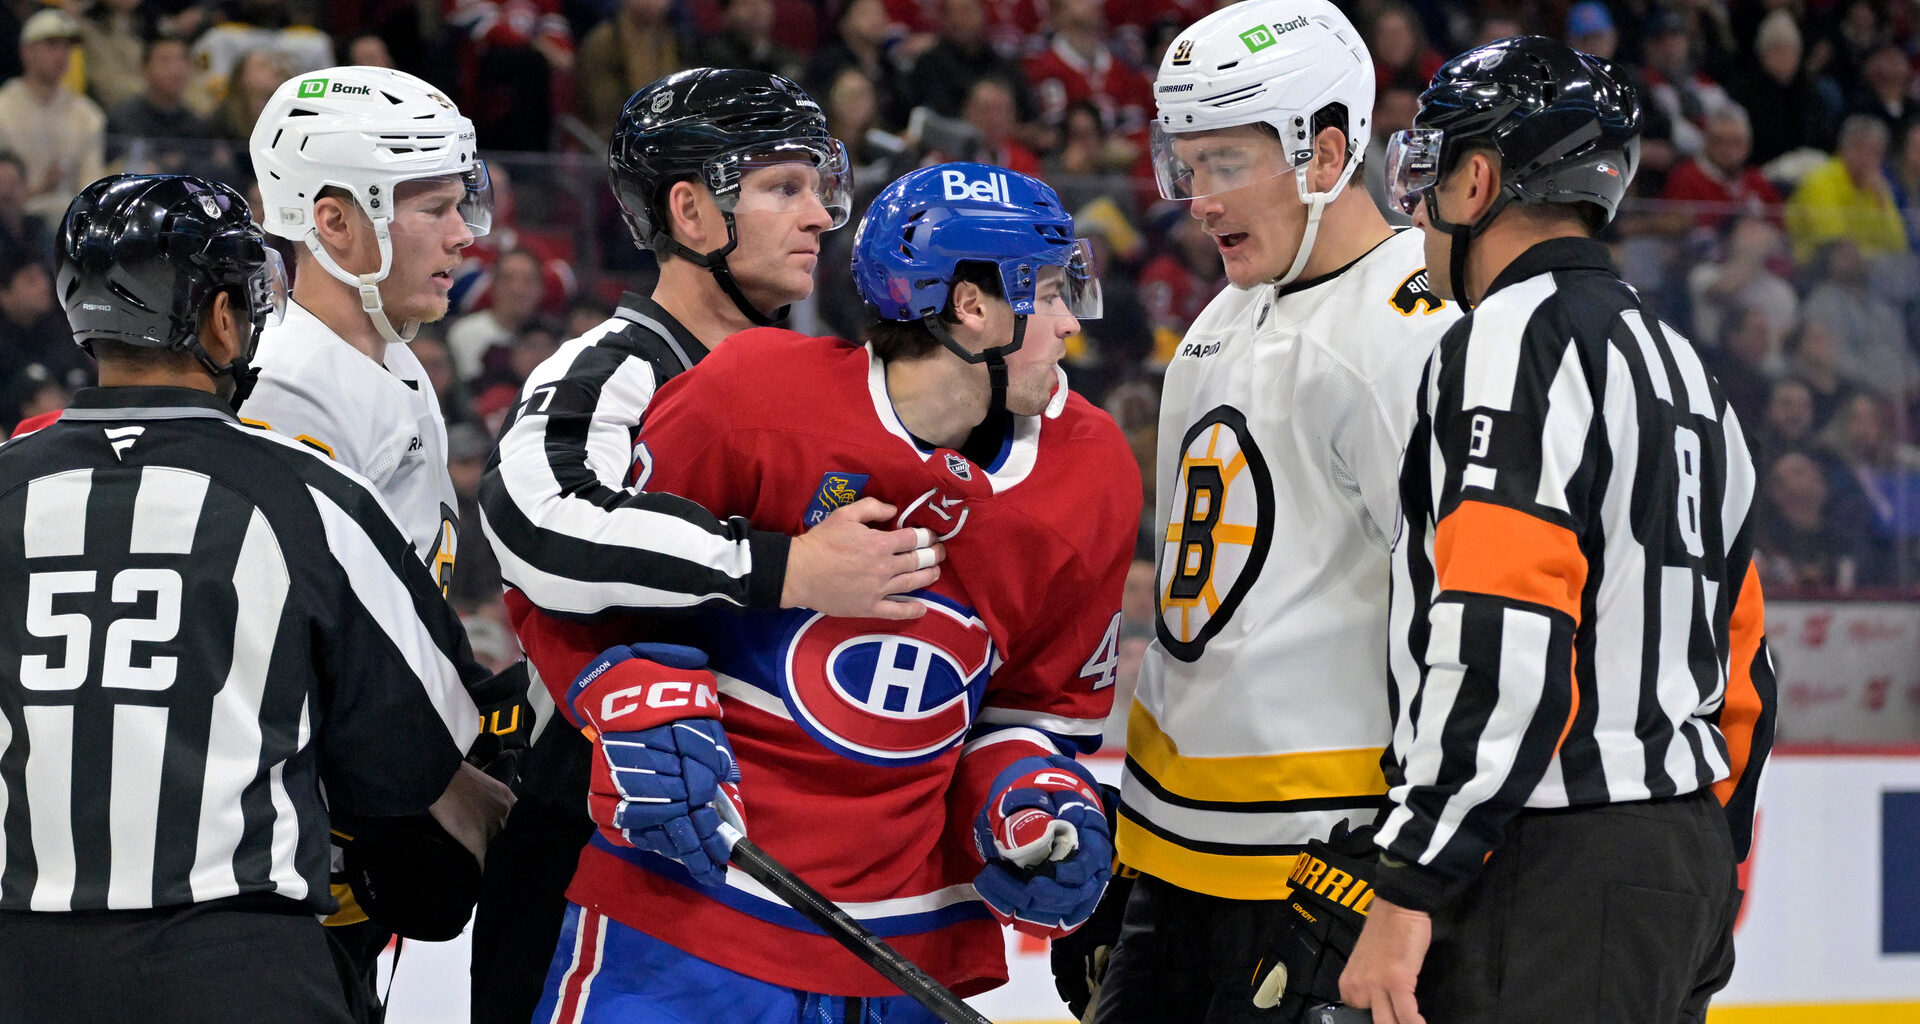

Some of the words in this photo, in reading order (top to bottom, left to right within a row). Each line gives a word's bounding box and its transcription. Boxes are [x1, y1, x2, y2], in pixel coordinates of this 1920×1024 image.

[1272, 15, 1310, 36] Bank
[331, 82, 371, 96] Bank
[1158, 83, 1194, 94] WARRIOR
[715, 183, 739, 196] BAUER
[942, 170, 1010, 203] Bell
[1468, 413, 1494, 458] 8
[1674, 424, 1705, 559] 8
[1169, 464, 1225, 600] B
[20, 568, 183, 691] 52
[578, 660, 612, 689] DAVIDSON
[600, 681, 719, 722] CCM
[1292, 902, 1318, 924] COVERT
